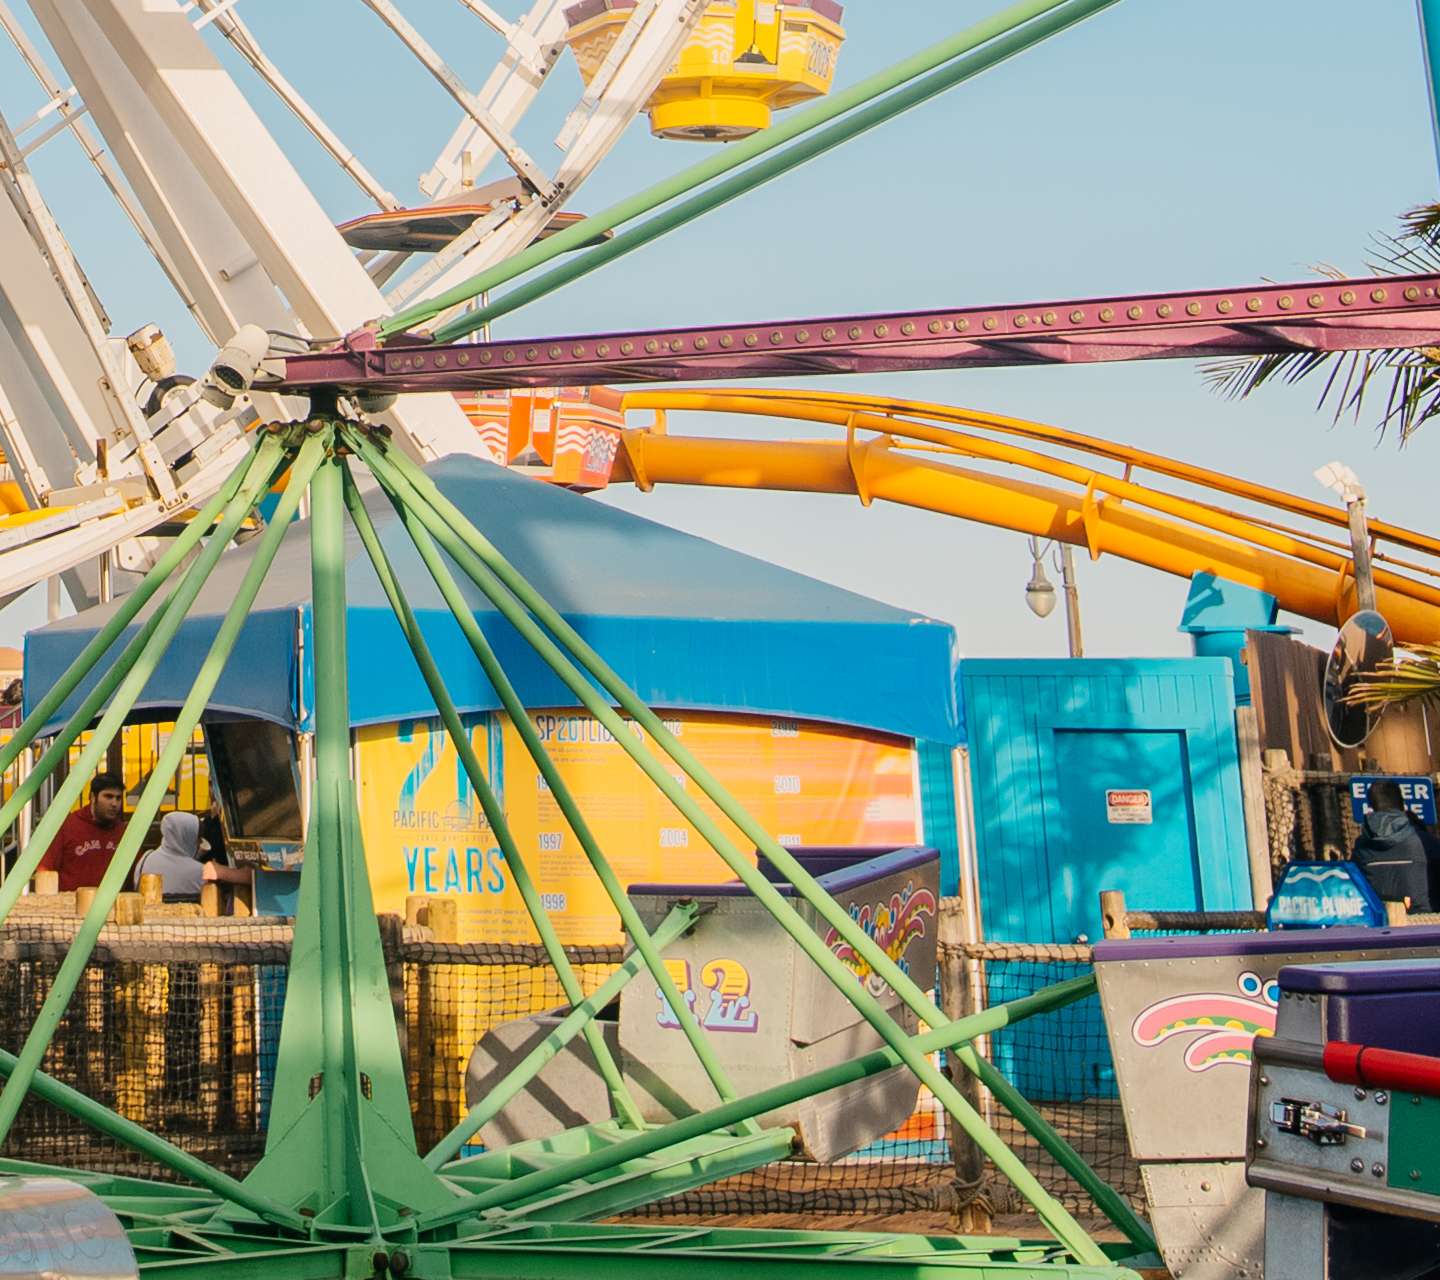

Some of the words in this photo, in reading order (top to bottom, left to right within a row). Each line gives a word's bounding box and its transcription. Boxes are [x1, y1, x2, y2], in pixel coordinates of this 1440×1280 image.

[397, 709, 505, 819] 20
[1352, 783, 1430, 800] EER
[393, 810, 440, 829] PACIFIC
[538, 832, 563, 850] 1997
[403, 846, 506, 894] YEARS
[540, 894, 566, 911] 1998
[1278, 895, 1319, 916] PACIFIC
[656, 958, 759, 1032] 12
